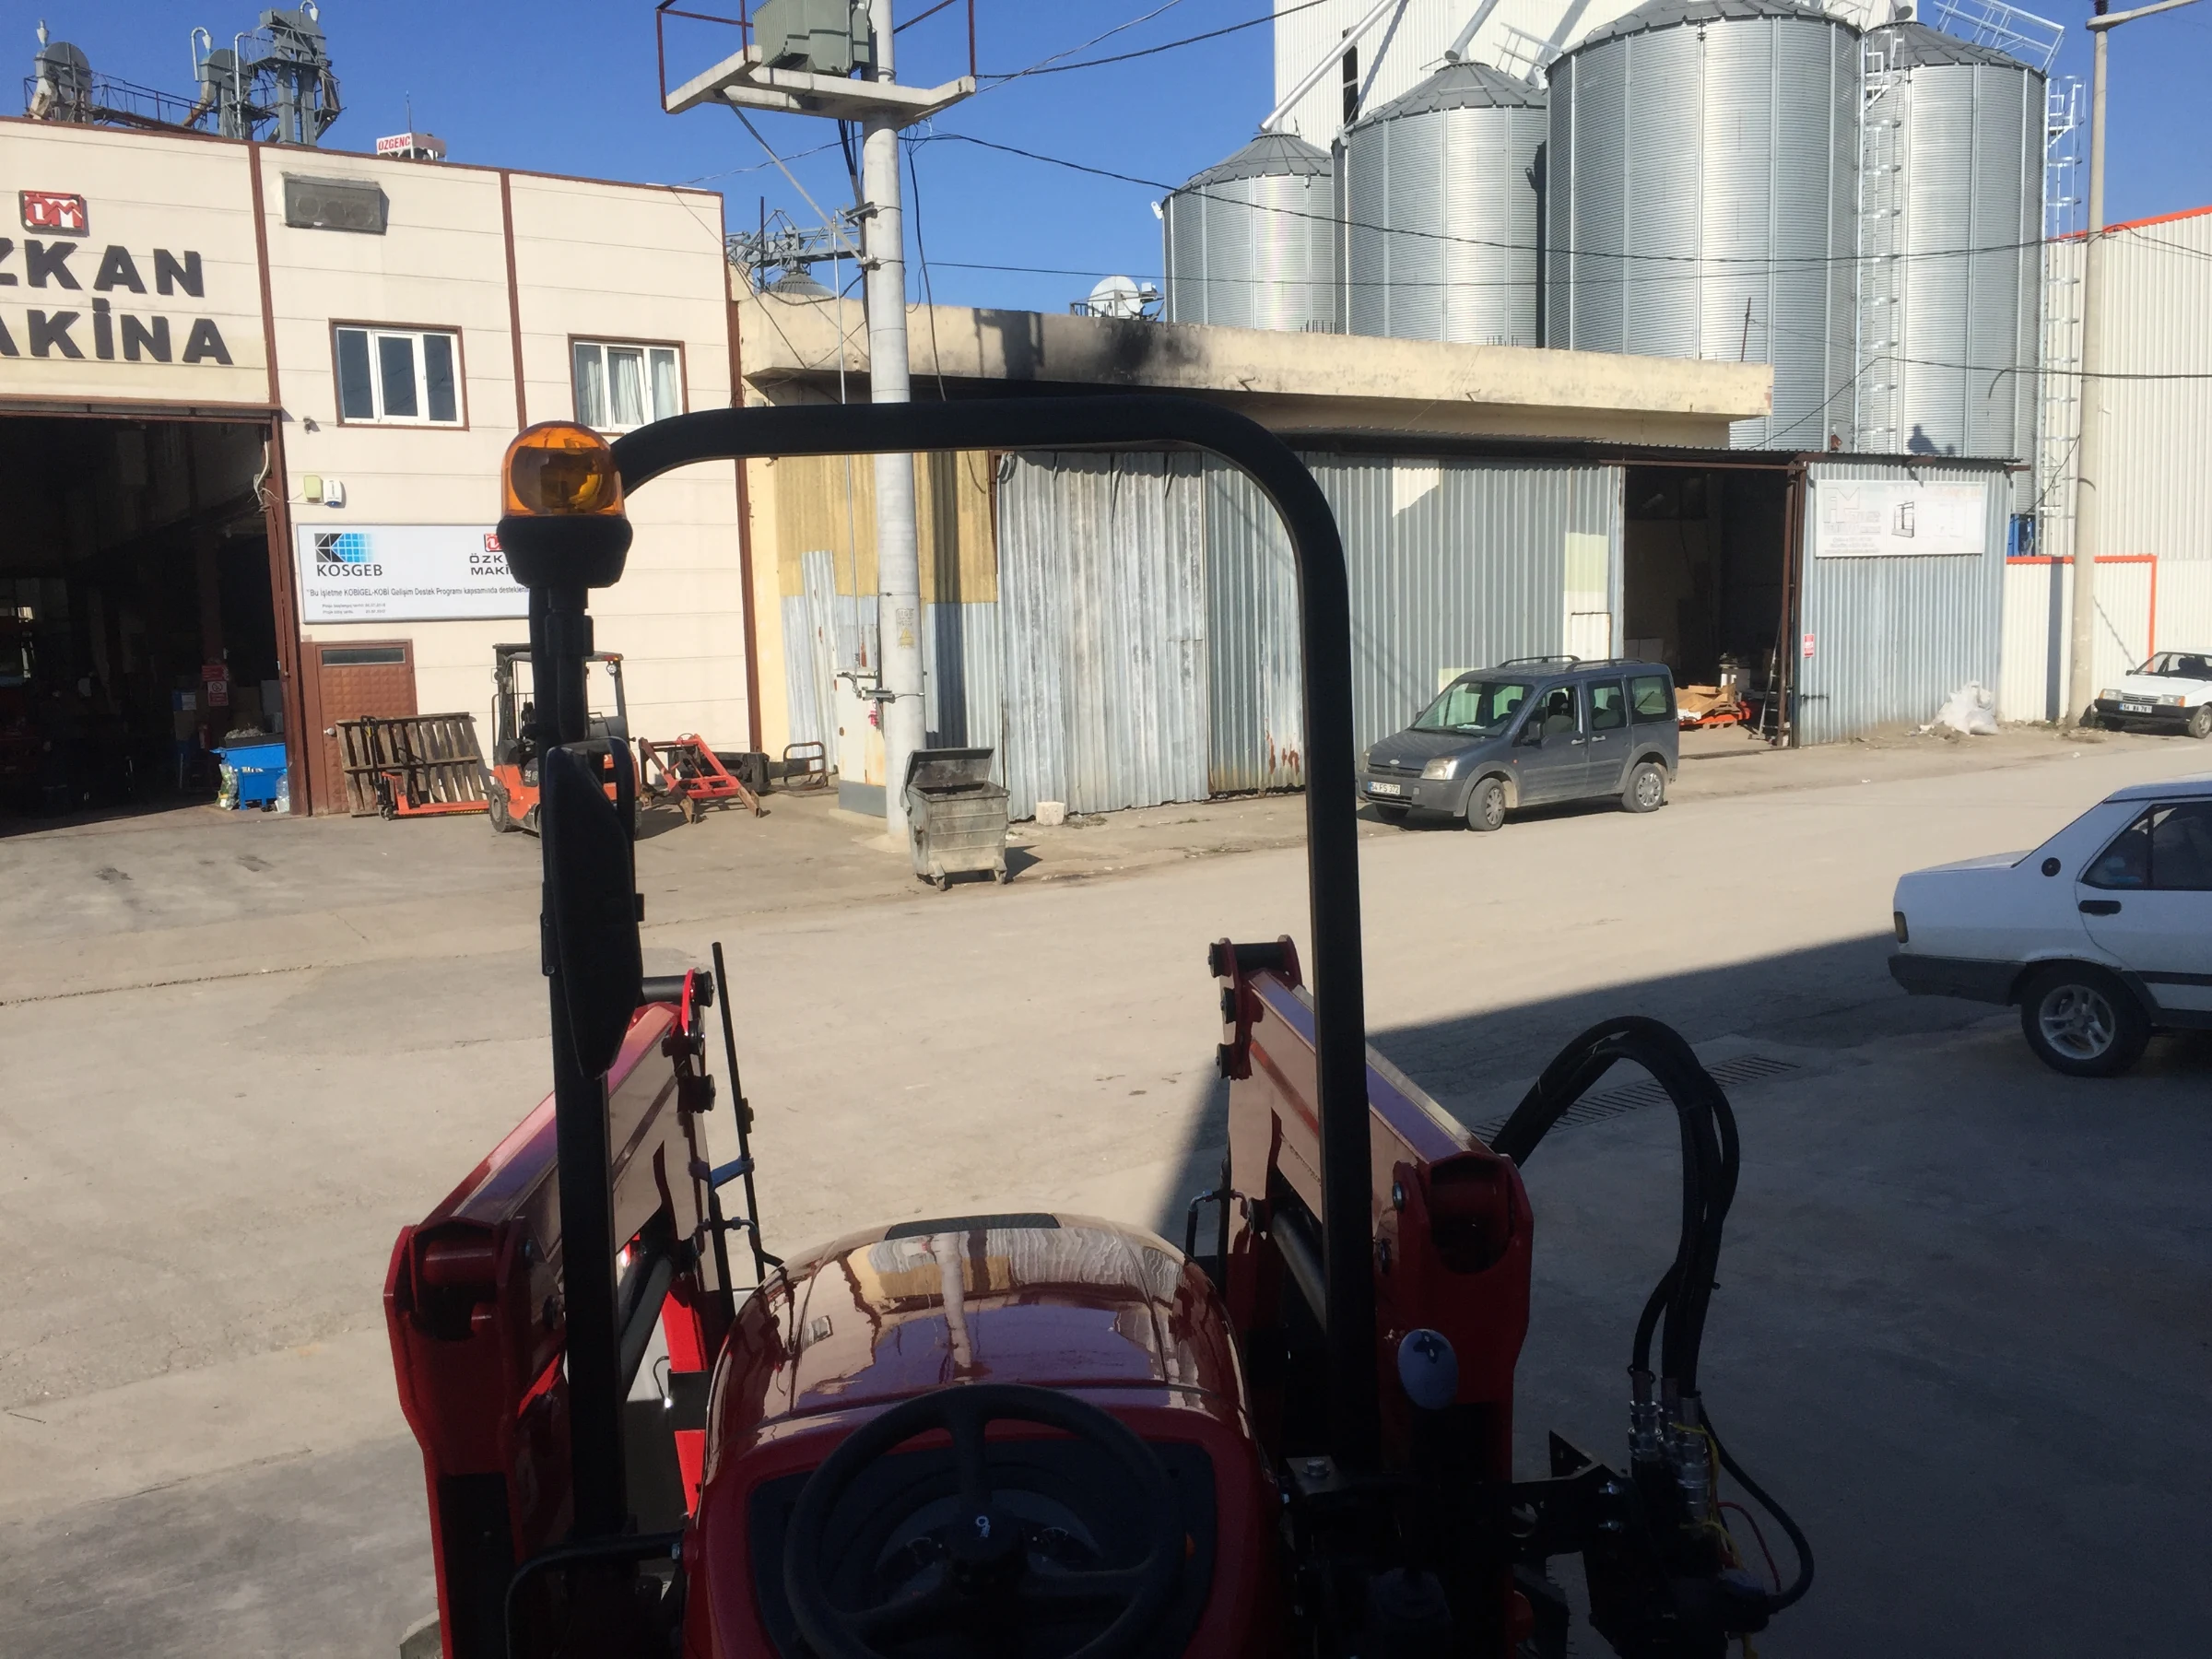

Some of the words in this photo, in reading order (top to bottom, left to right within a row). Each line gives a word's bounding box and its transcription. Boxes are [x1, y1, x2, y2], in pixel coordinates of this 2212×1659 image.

[469, 553, 503, 564] ÖZK
[316, 564, 383, 577] KOSGEB
[470, 563, 513, 576] MAKİ
[414, 587, 435, 595] Destek
